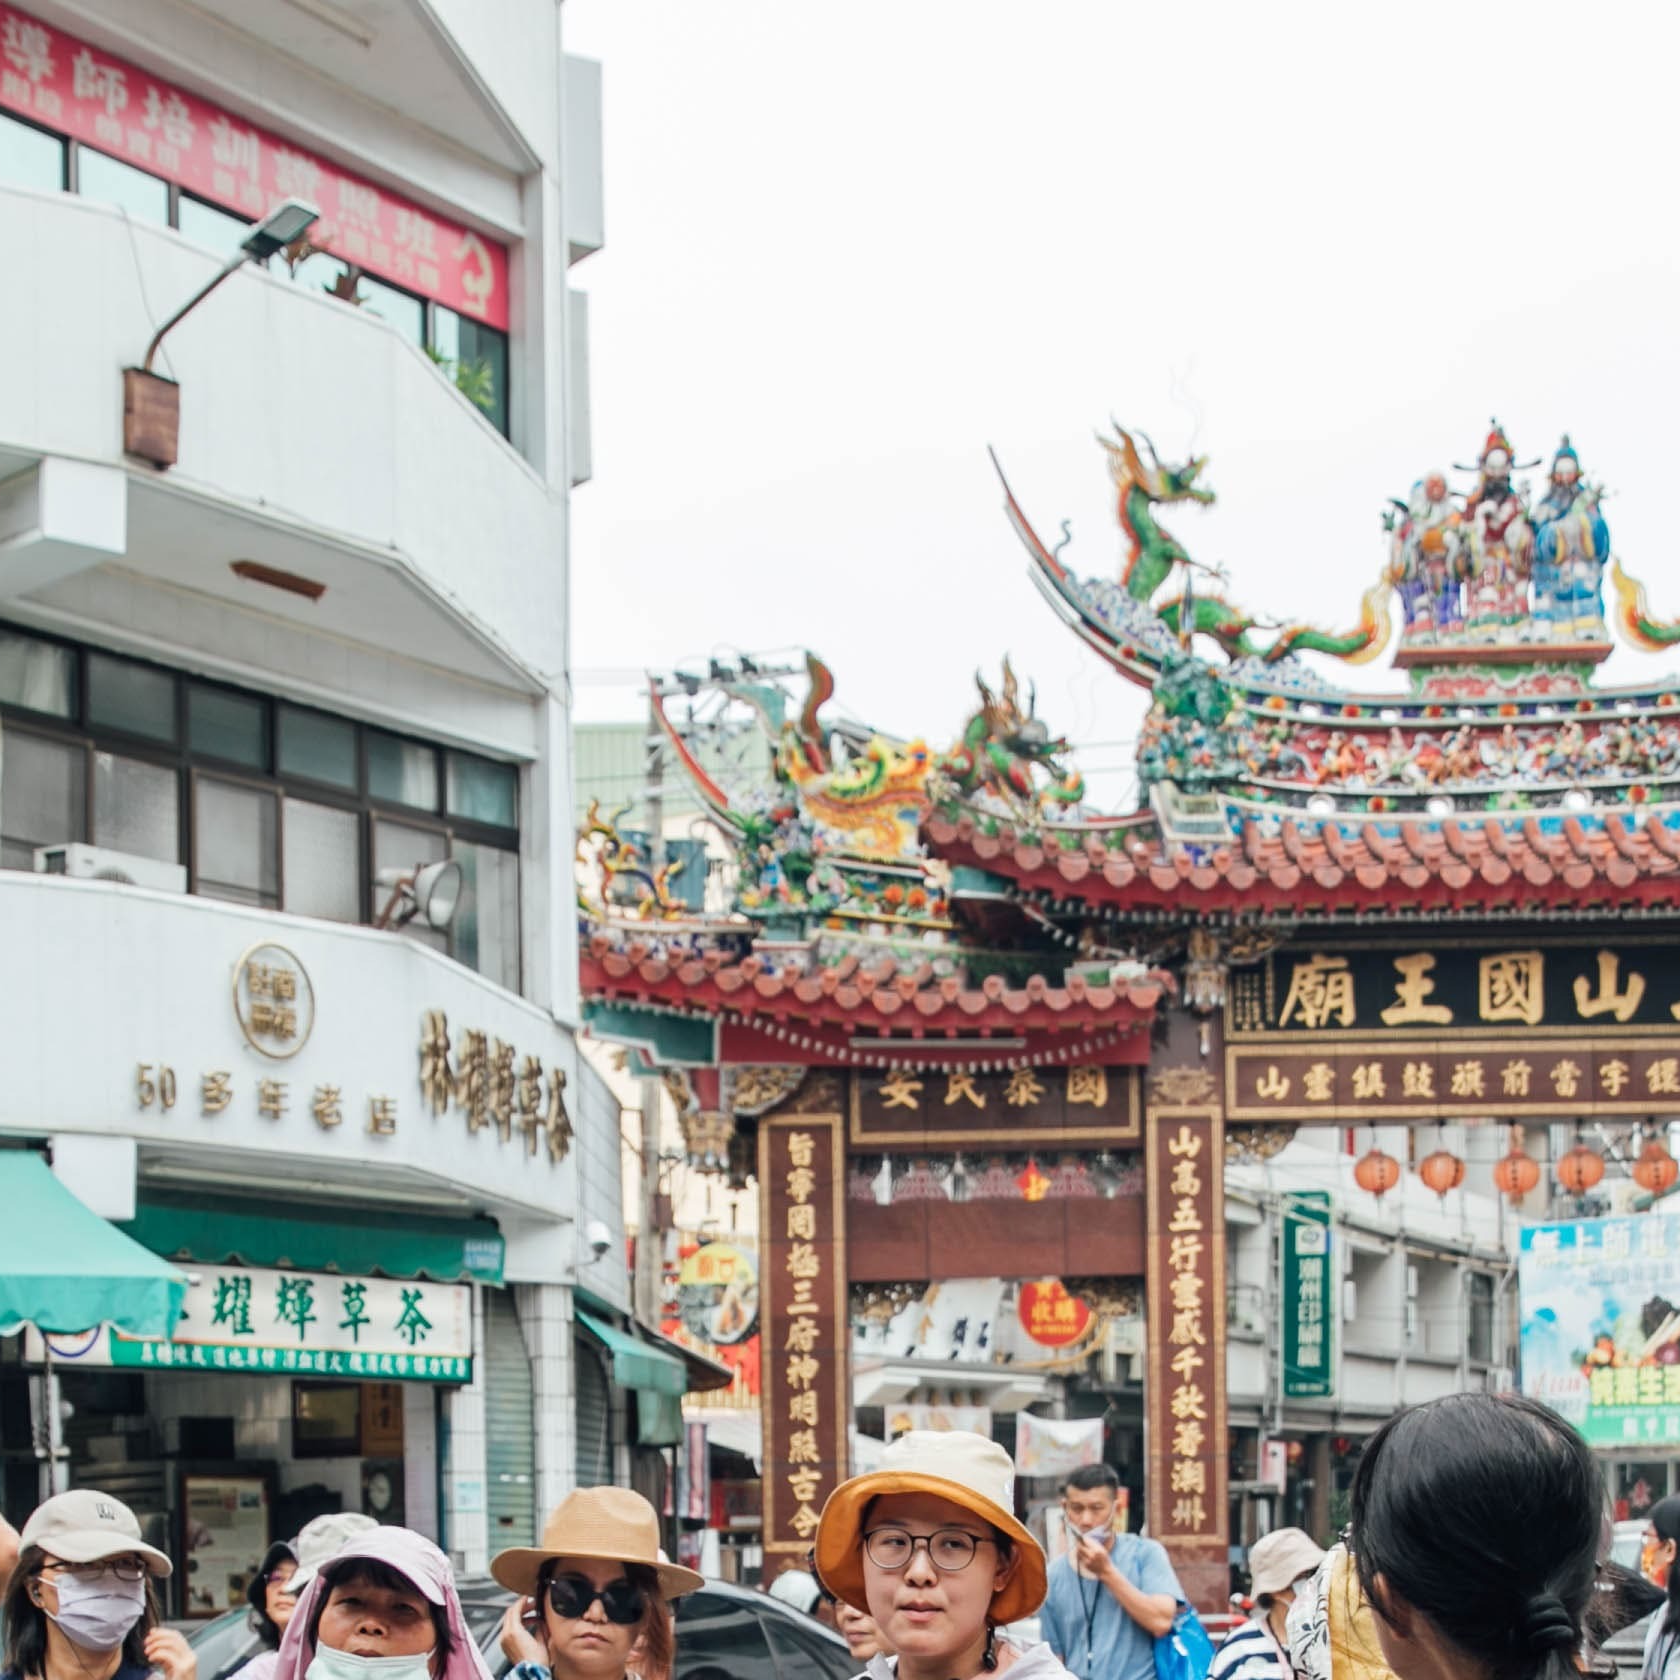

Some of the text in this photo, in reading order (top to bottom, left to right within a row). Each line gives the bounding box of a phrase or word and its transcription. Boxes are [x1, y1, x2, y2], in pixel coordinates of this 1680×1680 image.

[136, 1062, 398, 1137] 50多年老店
[182, 1274, 433, 1345] 耀輝草茶
